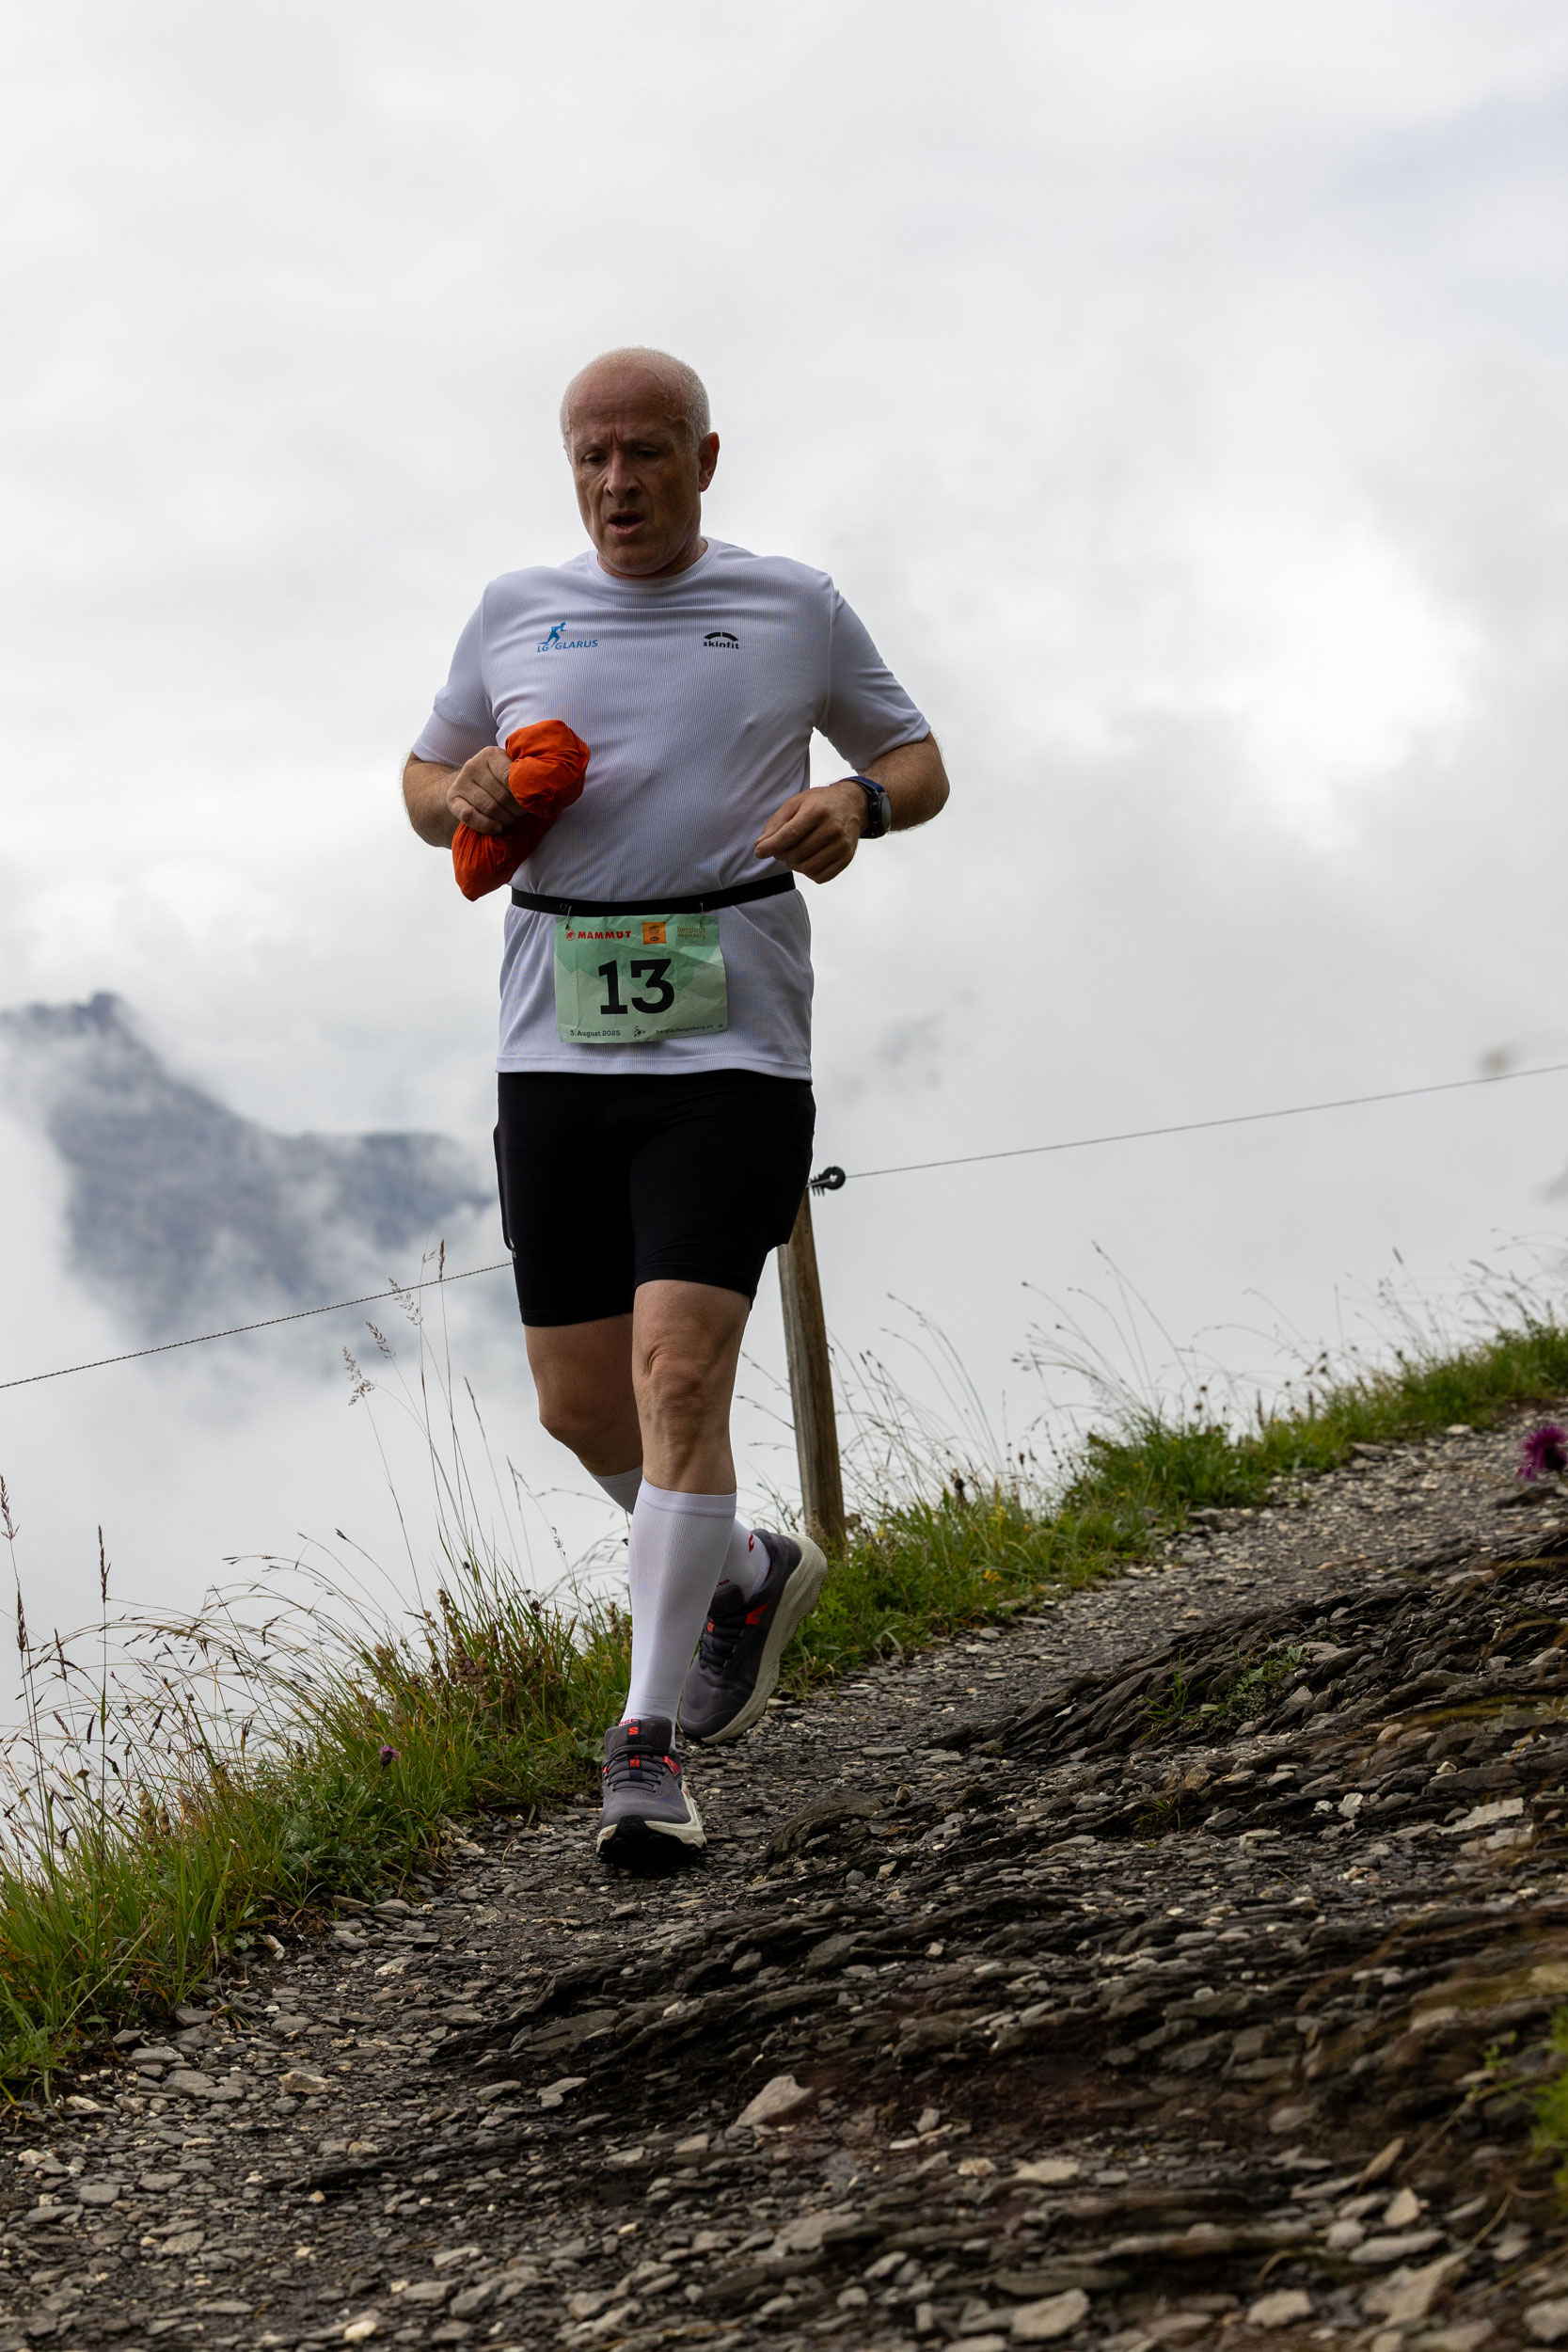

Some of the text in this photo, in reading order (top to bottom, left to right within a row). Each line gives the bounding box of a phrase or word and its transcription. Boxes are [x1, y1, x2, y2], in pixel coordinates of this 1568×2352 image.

[537, 639, 598, 653] LG GLARUS
[703, 640, 739, 650] skinfit
[577, 930, 632, 940] MAMMUT
[598, 958, 674, 1015] 13
[577, 1029, 601, 1039] August
